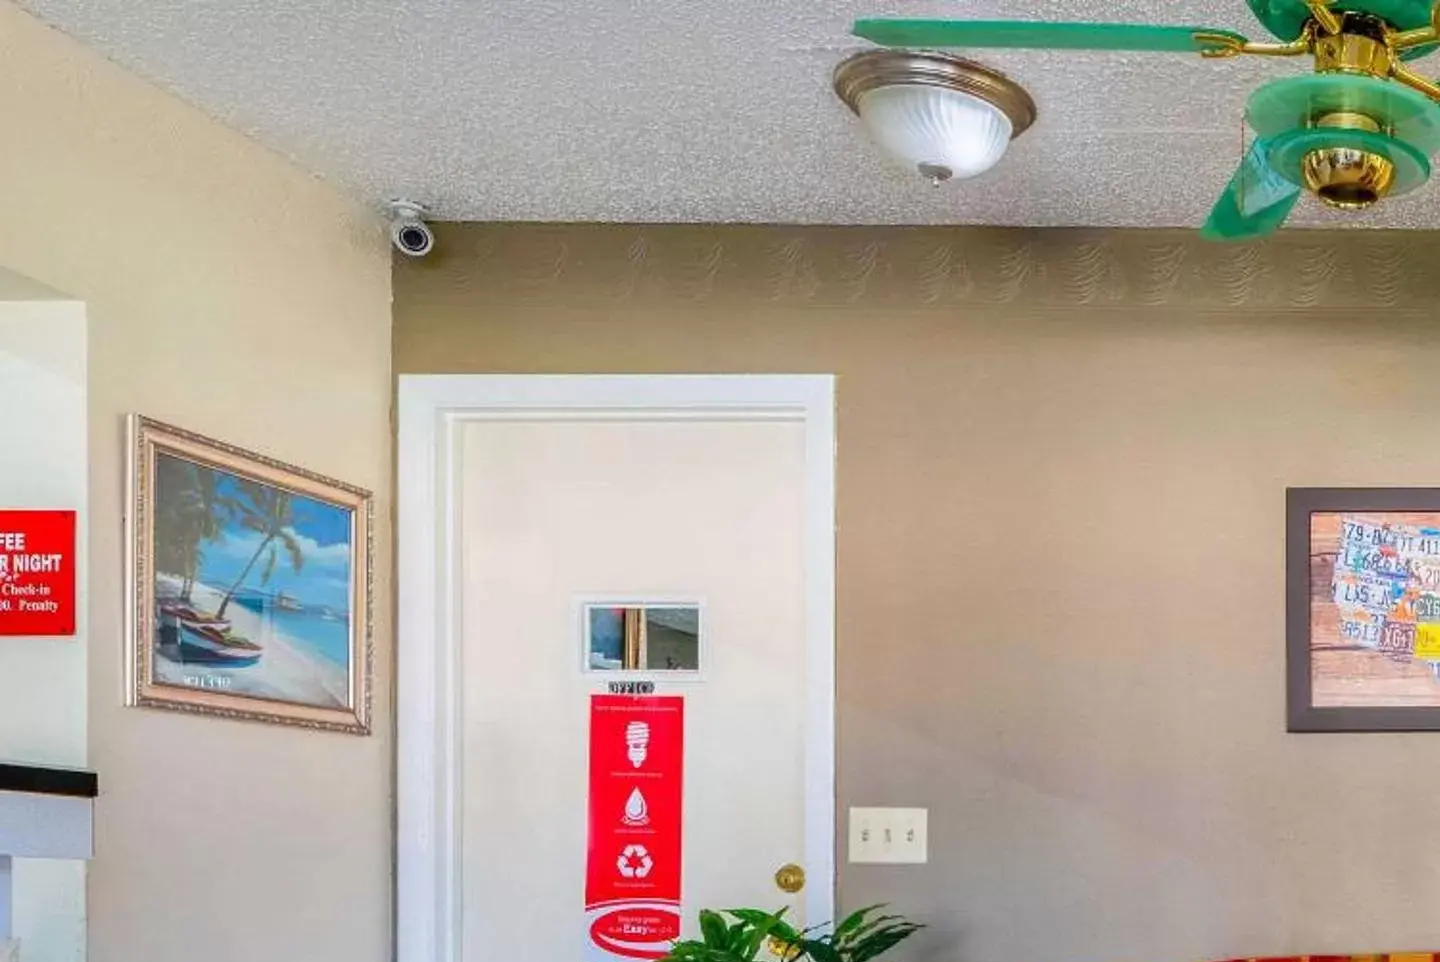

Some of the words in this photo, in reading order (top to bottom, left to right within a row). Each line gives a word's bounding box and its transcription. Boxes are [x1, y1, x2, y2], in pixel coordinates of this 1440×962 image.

[13, 554, 62, 572] NIGHT
[1, 583, 51, 596] Check-in
[19, 600, 58, 613] Penalty
[623, 923, 648, 935] Easy
